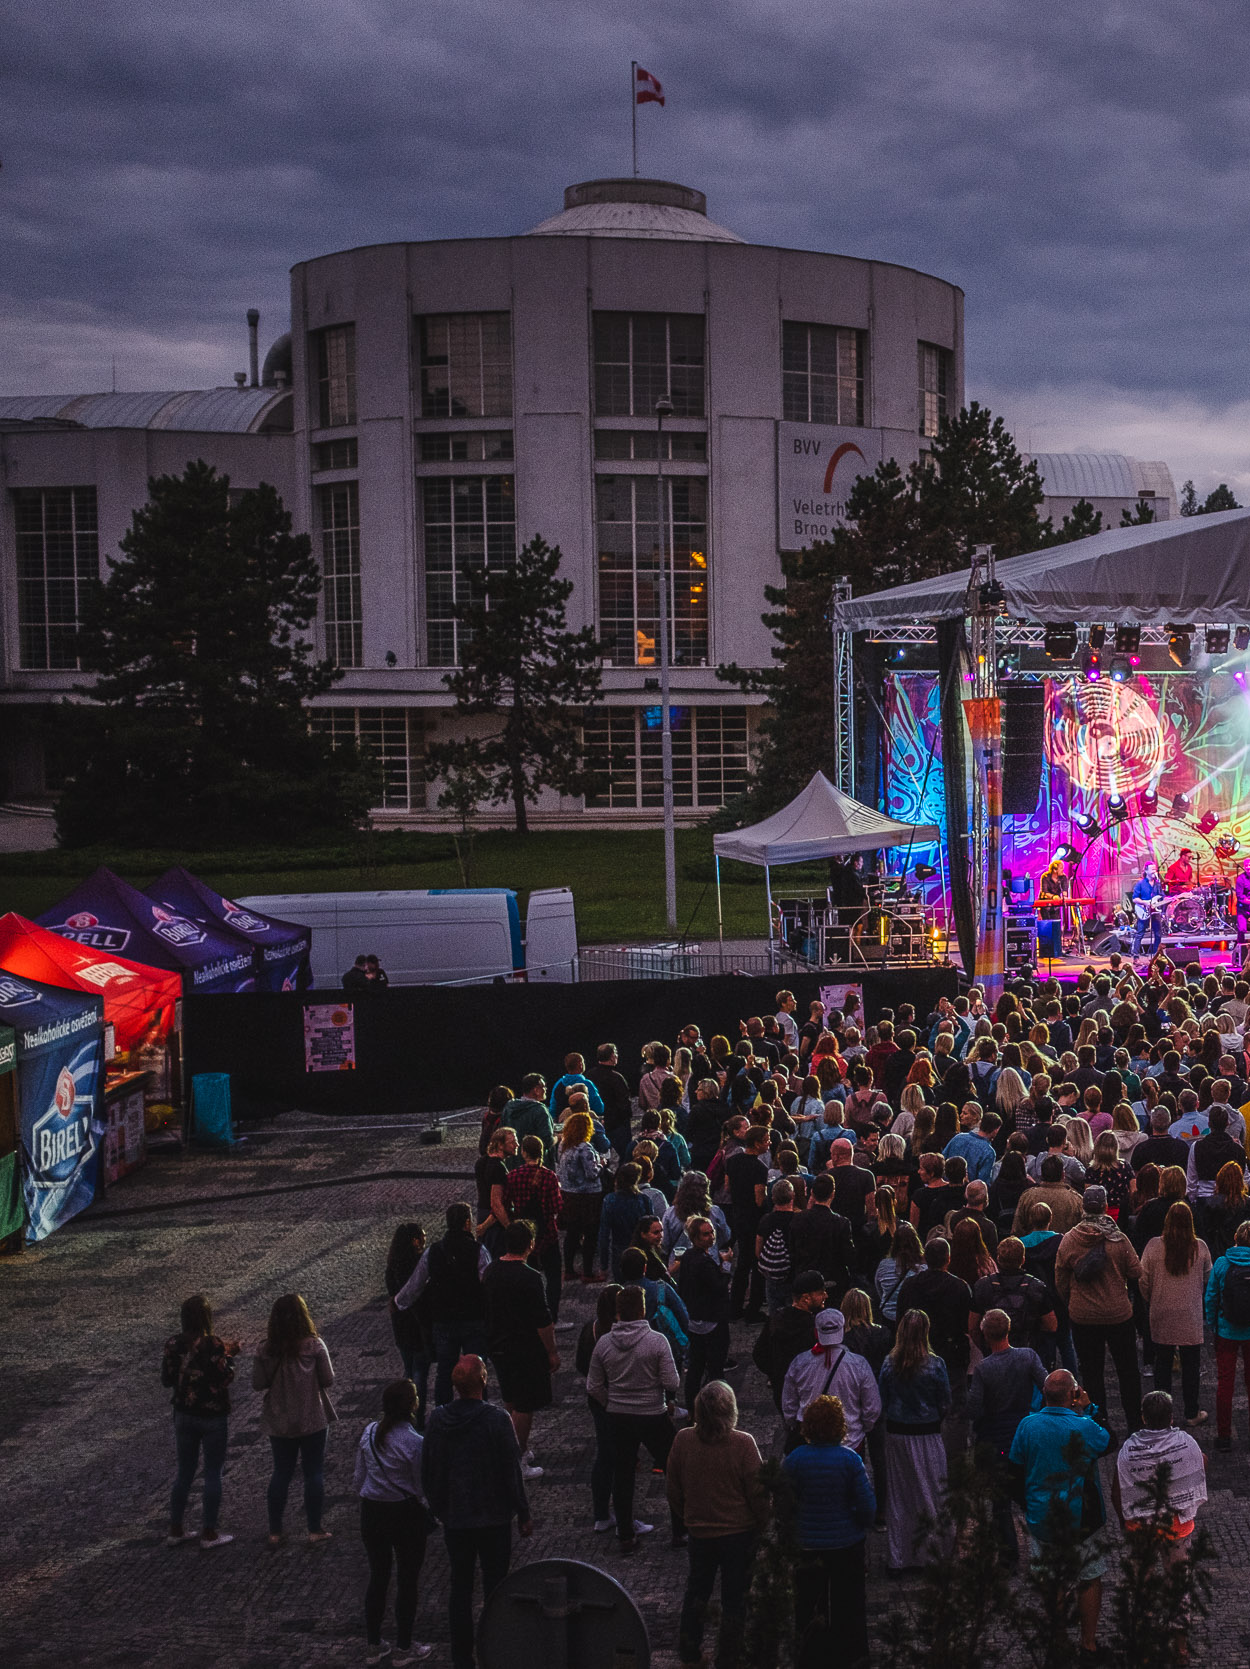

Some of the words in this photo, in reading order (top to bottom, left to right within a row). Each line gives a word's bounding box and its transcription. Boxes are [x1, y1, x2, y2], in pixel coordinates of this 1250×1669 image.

[793, 439, 820, 455] BVV
[793, 499, 845, 516] Veletrh
[794, 519, 828, 536] Brno
[24, 1017, 70, 1050] Nealkoholické
[71, 1005, 98, 1033] osvěžení
